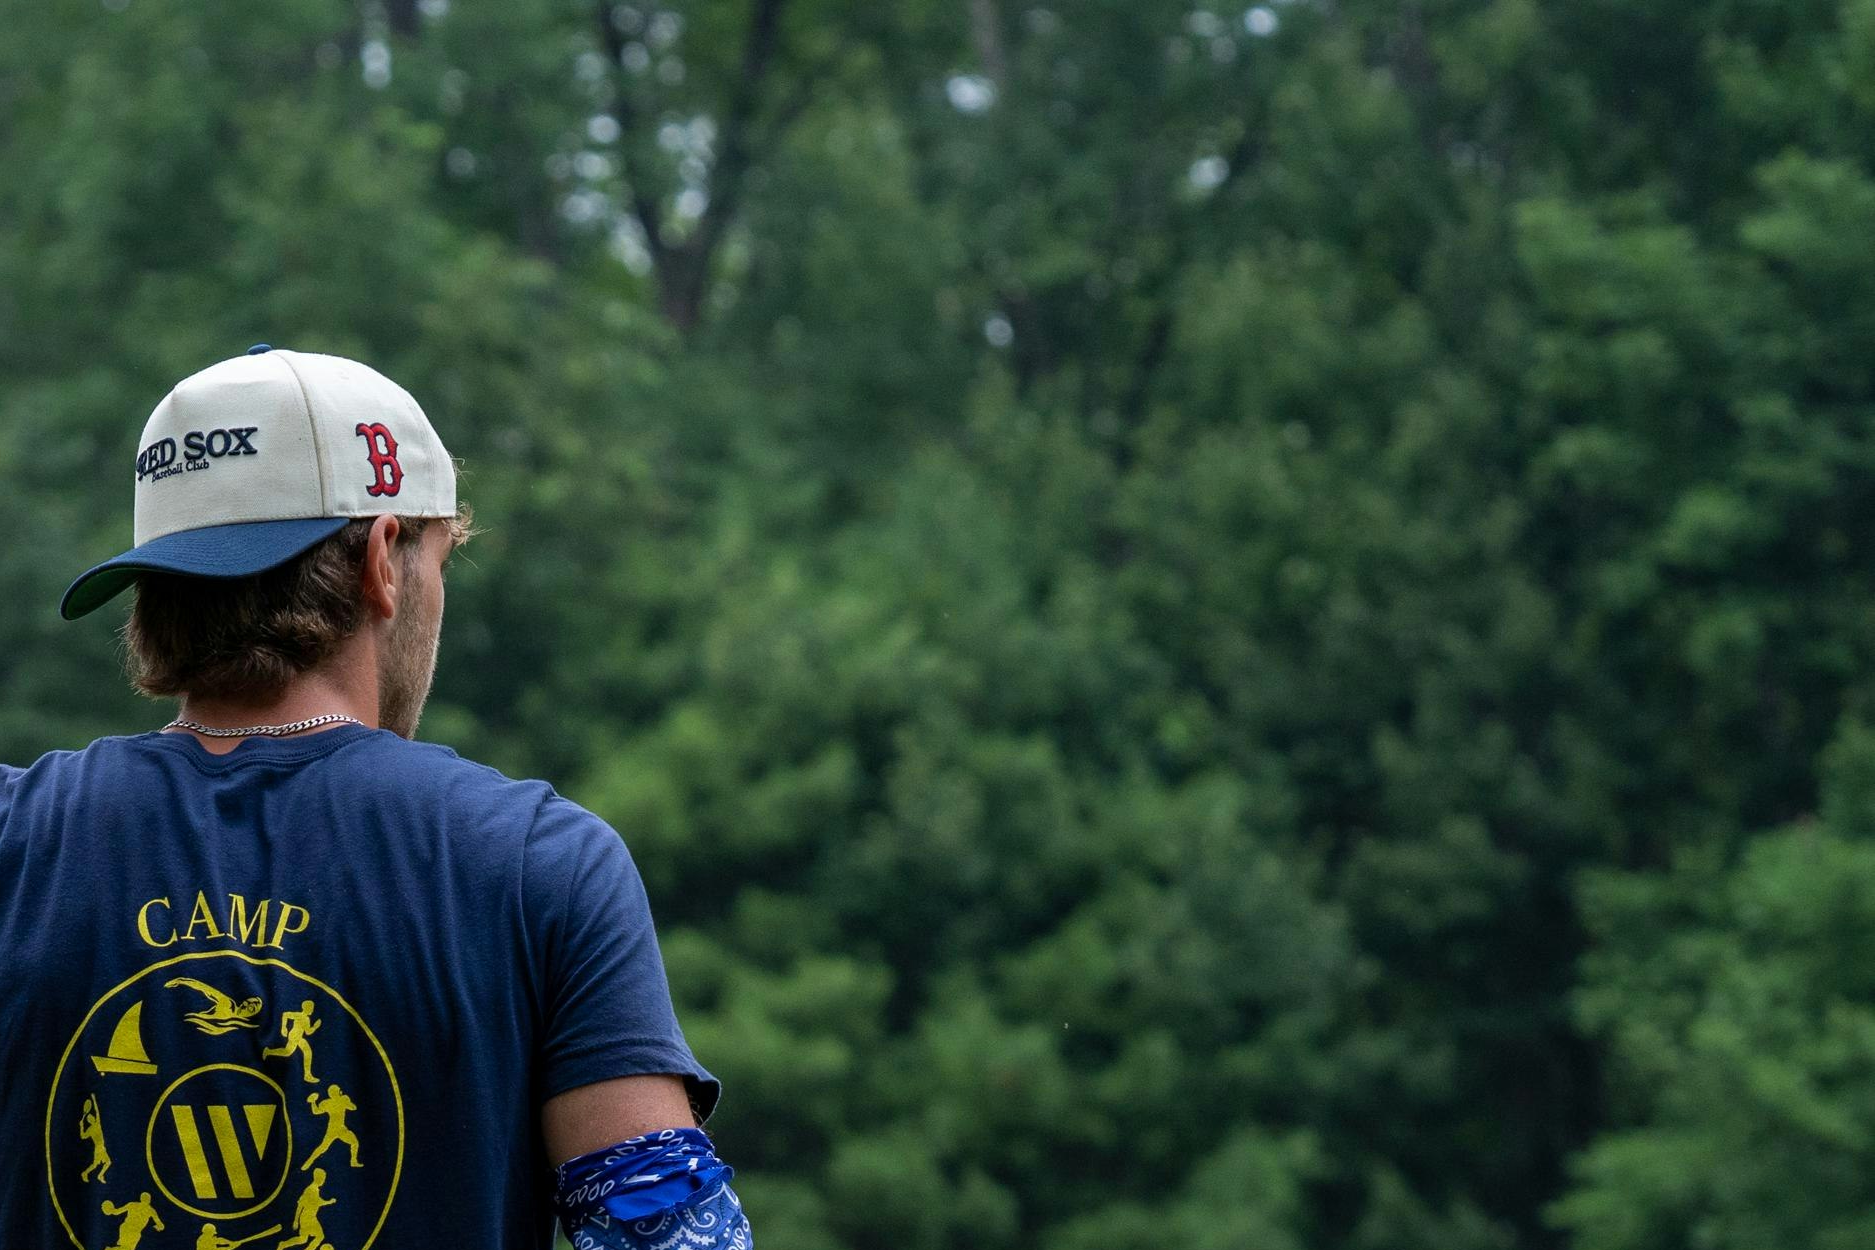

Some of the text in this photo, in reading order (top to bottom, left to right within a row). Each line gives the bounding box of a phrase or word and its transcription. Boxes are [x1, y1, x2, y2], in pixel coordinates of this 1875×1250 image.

[136, 426, 258, 481] RED SOX
[151, 458, 210, 483] Baseball Club
[355, 422, 405, 498] B
[136, 889, 311, 951] CAMP
